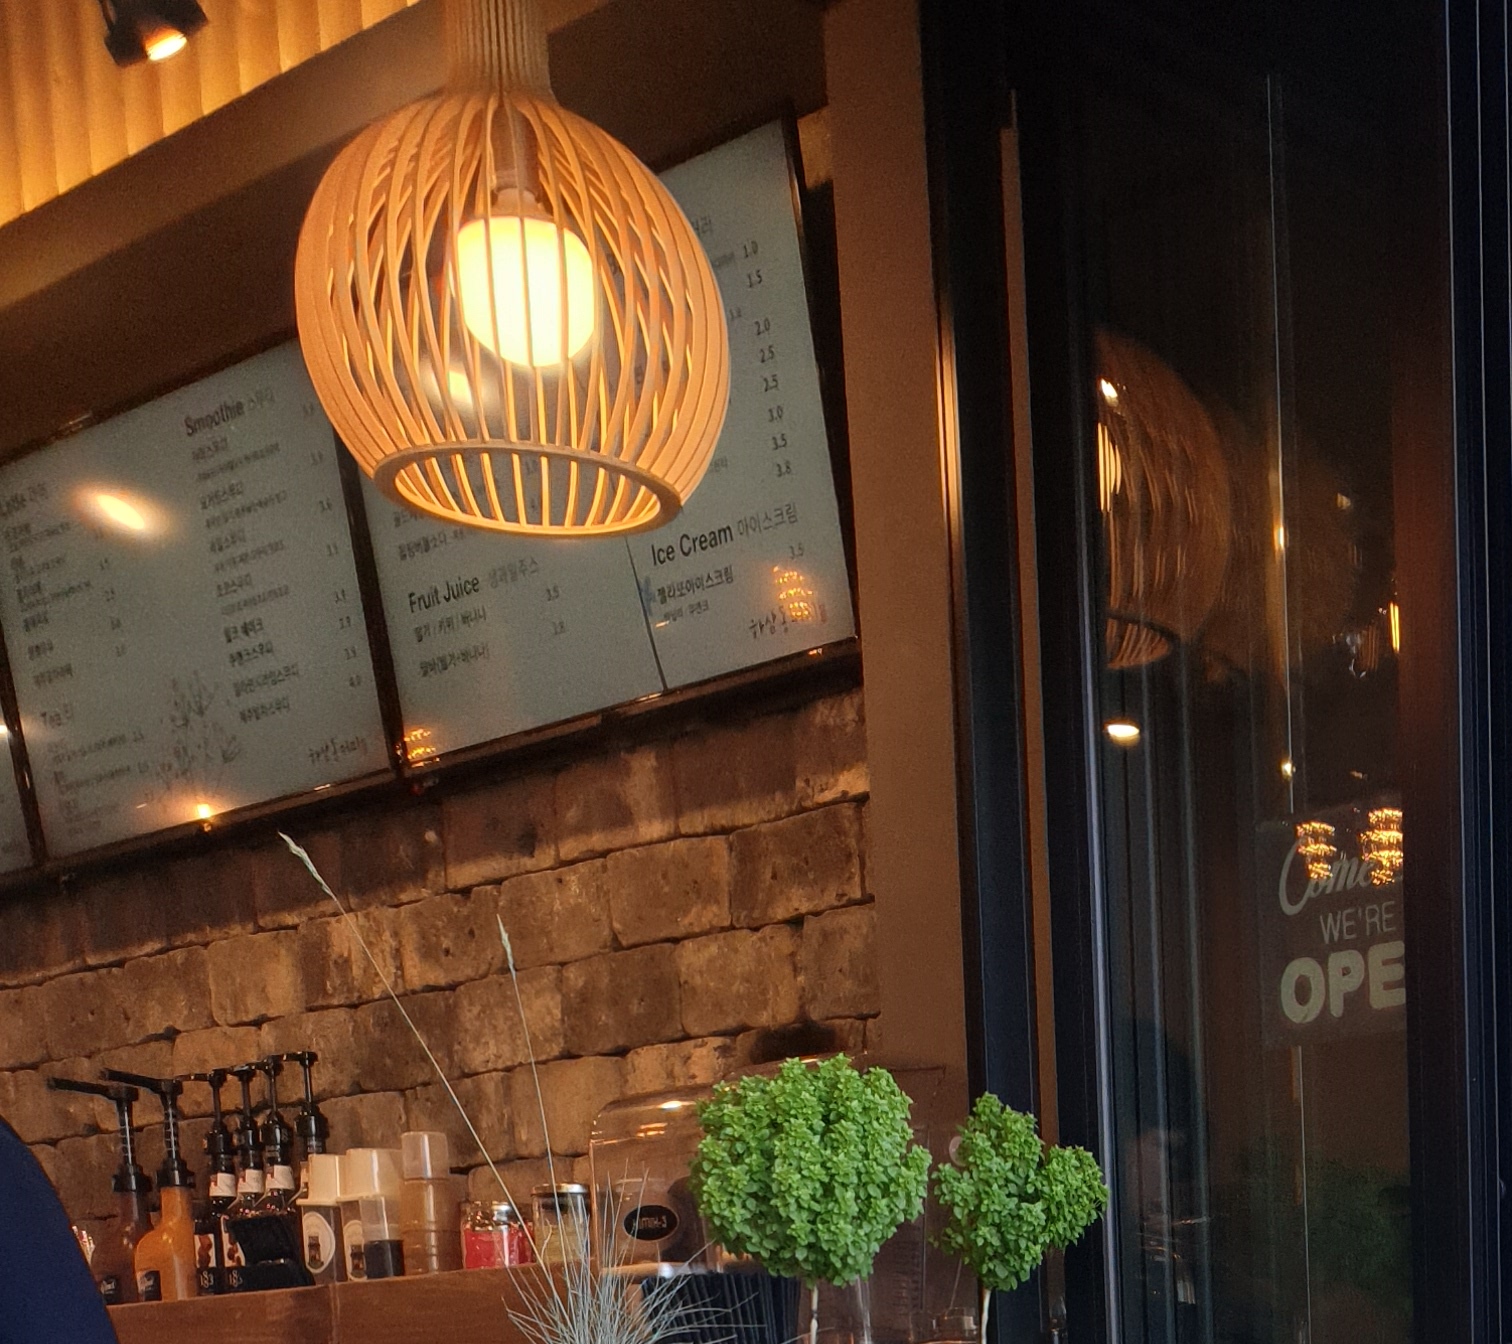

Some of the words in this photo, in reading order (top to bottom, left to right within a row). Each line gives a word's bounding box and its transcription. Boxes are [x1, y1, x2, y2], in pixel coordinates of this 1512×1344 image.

[754, 318, 771, 336] 2.0
[760, 344, 775, 363] 2.5
[763, 373, 779, 393] 2.5
[184, 400, 245, 437] Smoothie
[772, 433, 788, 451] 3.5
[651, 544, 675, 566] Ice
[679, 524, 734, 557] Cream
[737, 502, 798, 537] 아이스크림
[408, 582, 440, 613] Fruit
[443, 576, 480, 602] Juice
[1319, 900, 1396, 944] WE'RE
